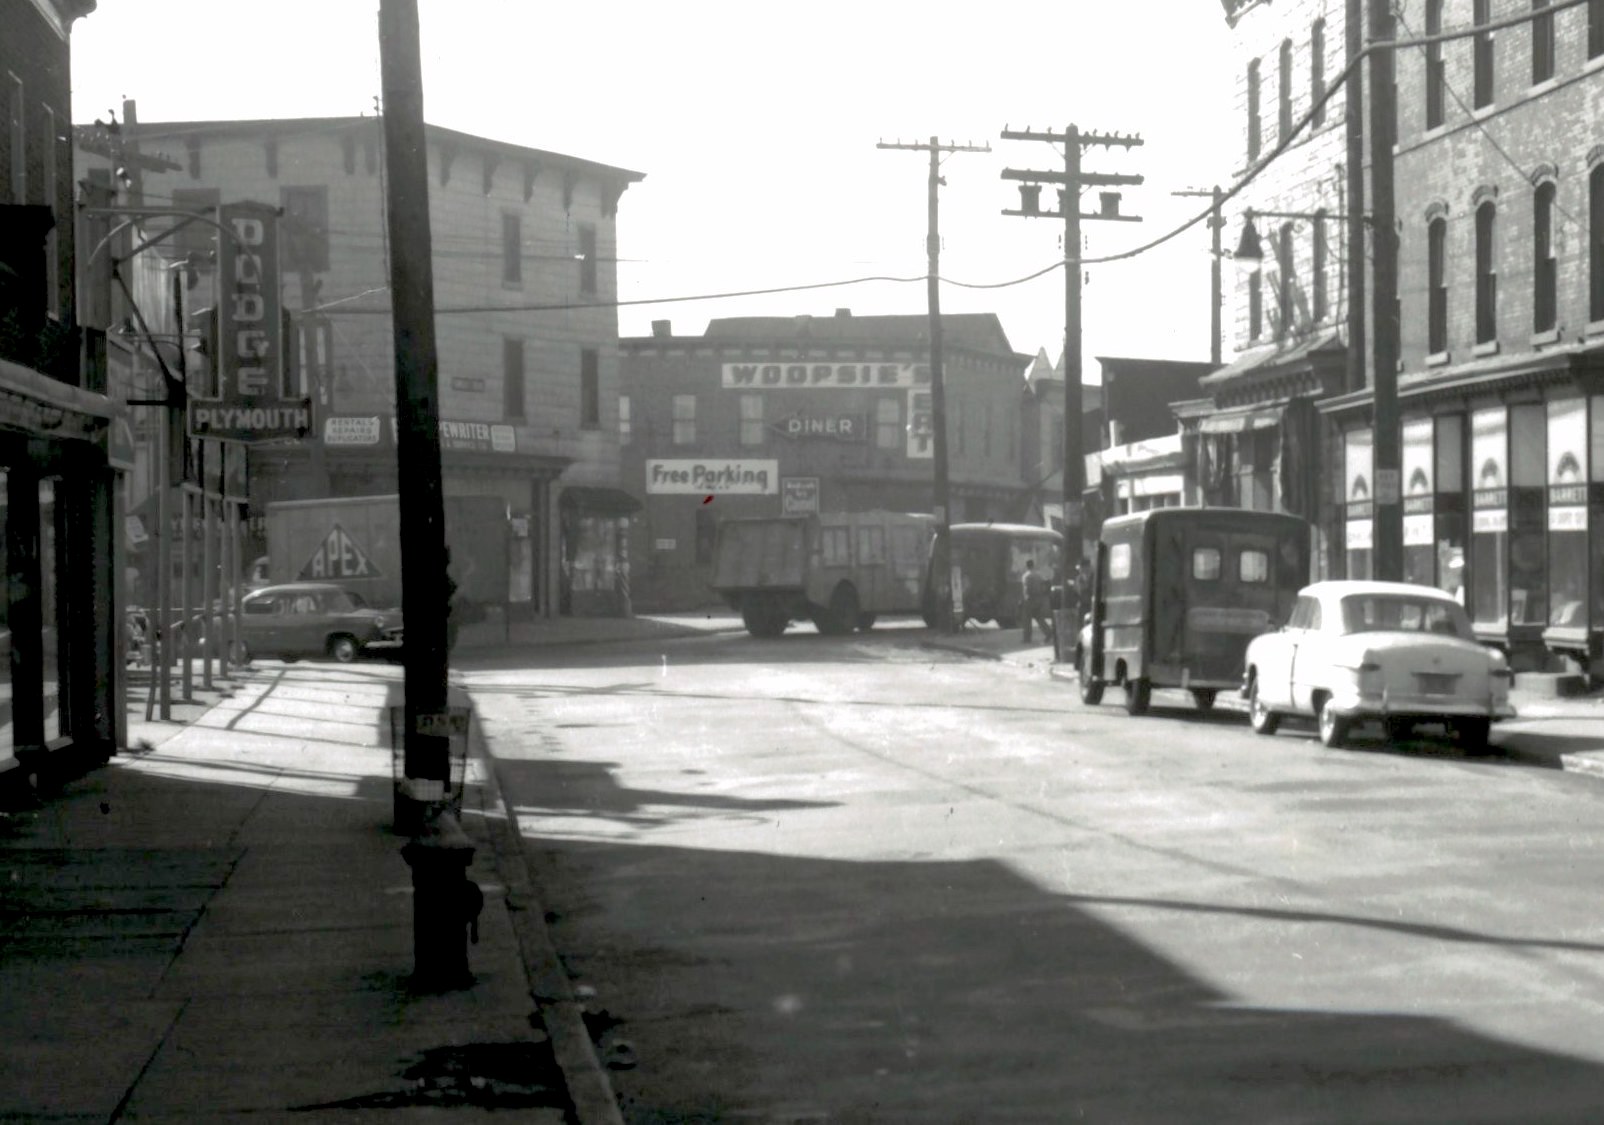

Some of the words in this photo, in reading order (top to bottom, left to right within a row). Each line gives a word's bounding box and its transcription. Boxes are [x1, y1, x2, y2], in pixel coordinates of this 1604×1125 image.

[231, 218, 269, 396] DODGE
[195, 408, 309, 430] PLYMOUTH
[788, 417, 853, 434] DINER
[652, 463, 690, 485] Free
[691, 463, 768, 490] Parking
[312, 528, 369, 578] APEX
